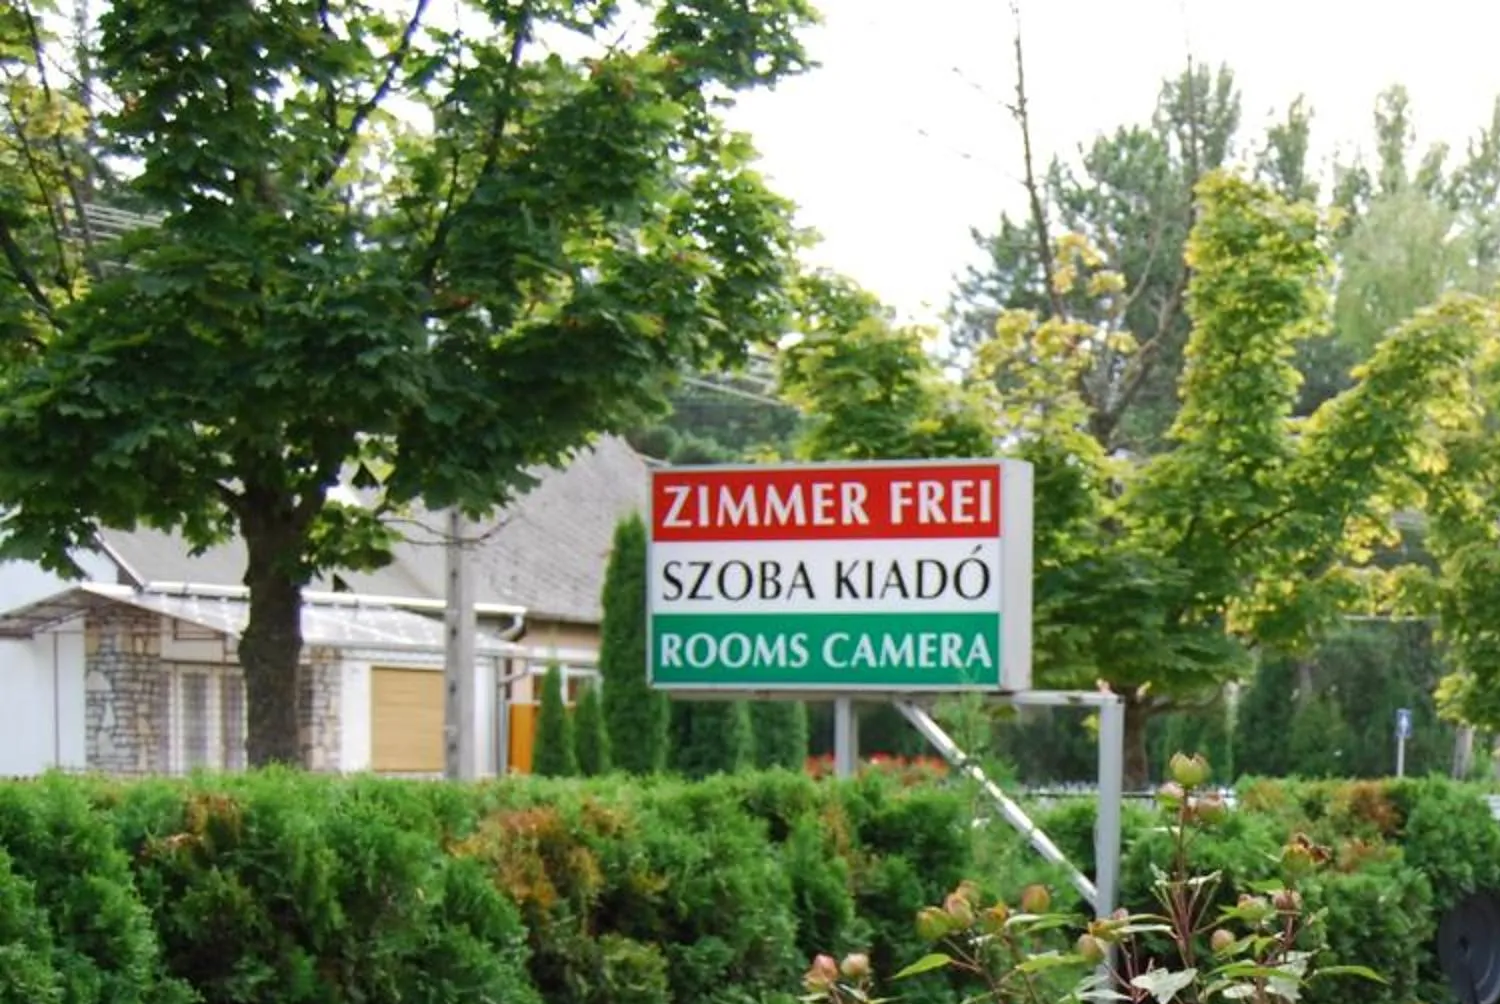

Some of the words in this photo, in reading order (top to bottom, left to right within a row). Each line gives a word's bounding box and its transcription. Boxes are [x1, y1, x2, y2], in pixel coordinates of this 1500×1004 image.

[662, 481, 869, 528] ZIMMER
[890, 479, 992, 524] FREI
[662, 560, 816, 601] SZOBA
[835, 545, 991, 600] KIADÓ
[660, 632, 809, 669] ROOMS
[822, 632, 992, 669] CAMERA
